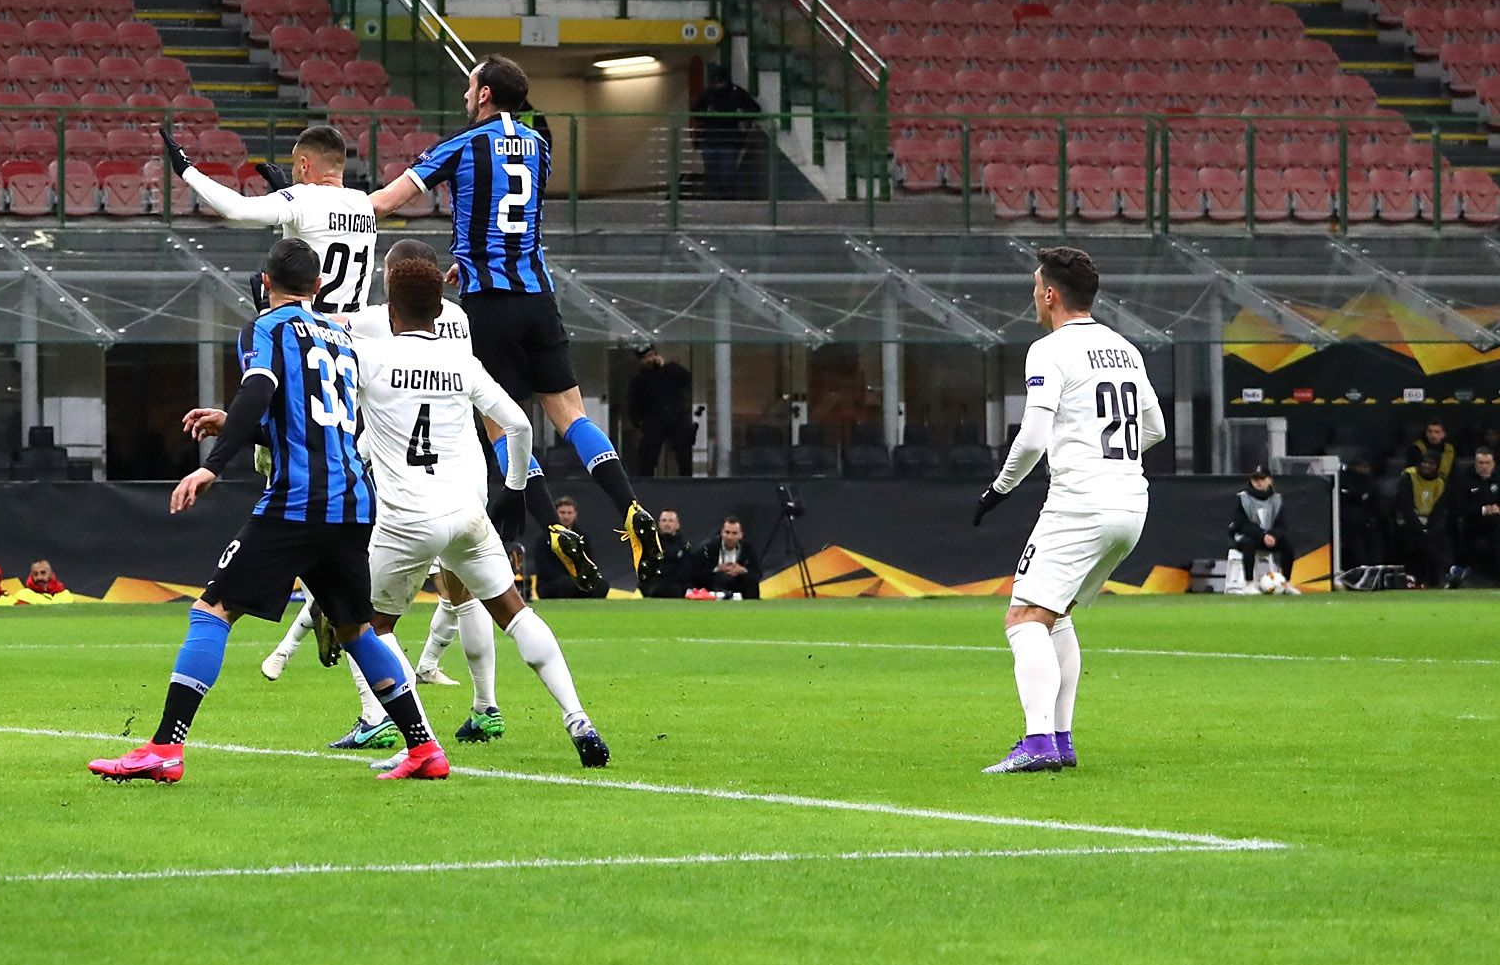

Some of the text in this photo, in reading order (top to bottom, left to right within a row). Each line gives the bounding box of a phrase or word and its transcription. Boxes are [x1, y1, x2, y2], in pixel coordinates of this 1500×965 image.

[494, 138, 536, 156] GODIN
[496, 163, 532, 234] 2
[312, 242, 369, 314] 21
[306, 346, 357, 435] 33
[390, 368, 464, 392] CICINHO
[406, 403, 438, 476] 4
[1095, 381, 1139, 461] 28
[1018, 543, 1037, 575] 8
